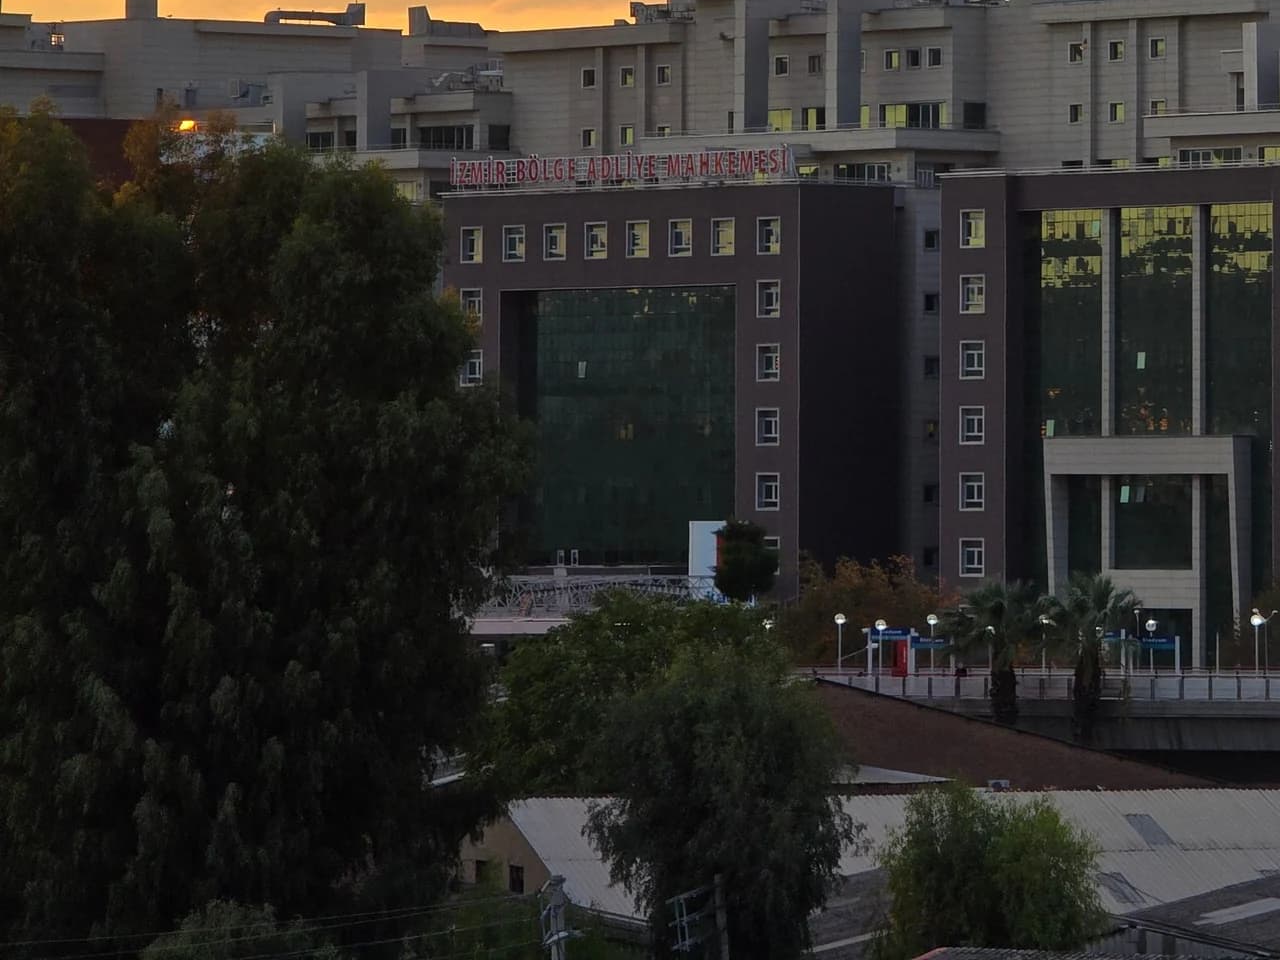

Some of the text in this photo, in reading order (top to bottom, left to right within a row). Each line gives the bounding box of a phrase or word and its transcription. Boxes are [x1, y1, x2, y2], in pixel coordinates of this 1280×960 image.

[450, 143, 789, 185] İZMİR BÖLGE ADLİYE MAHKEMESİ
